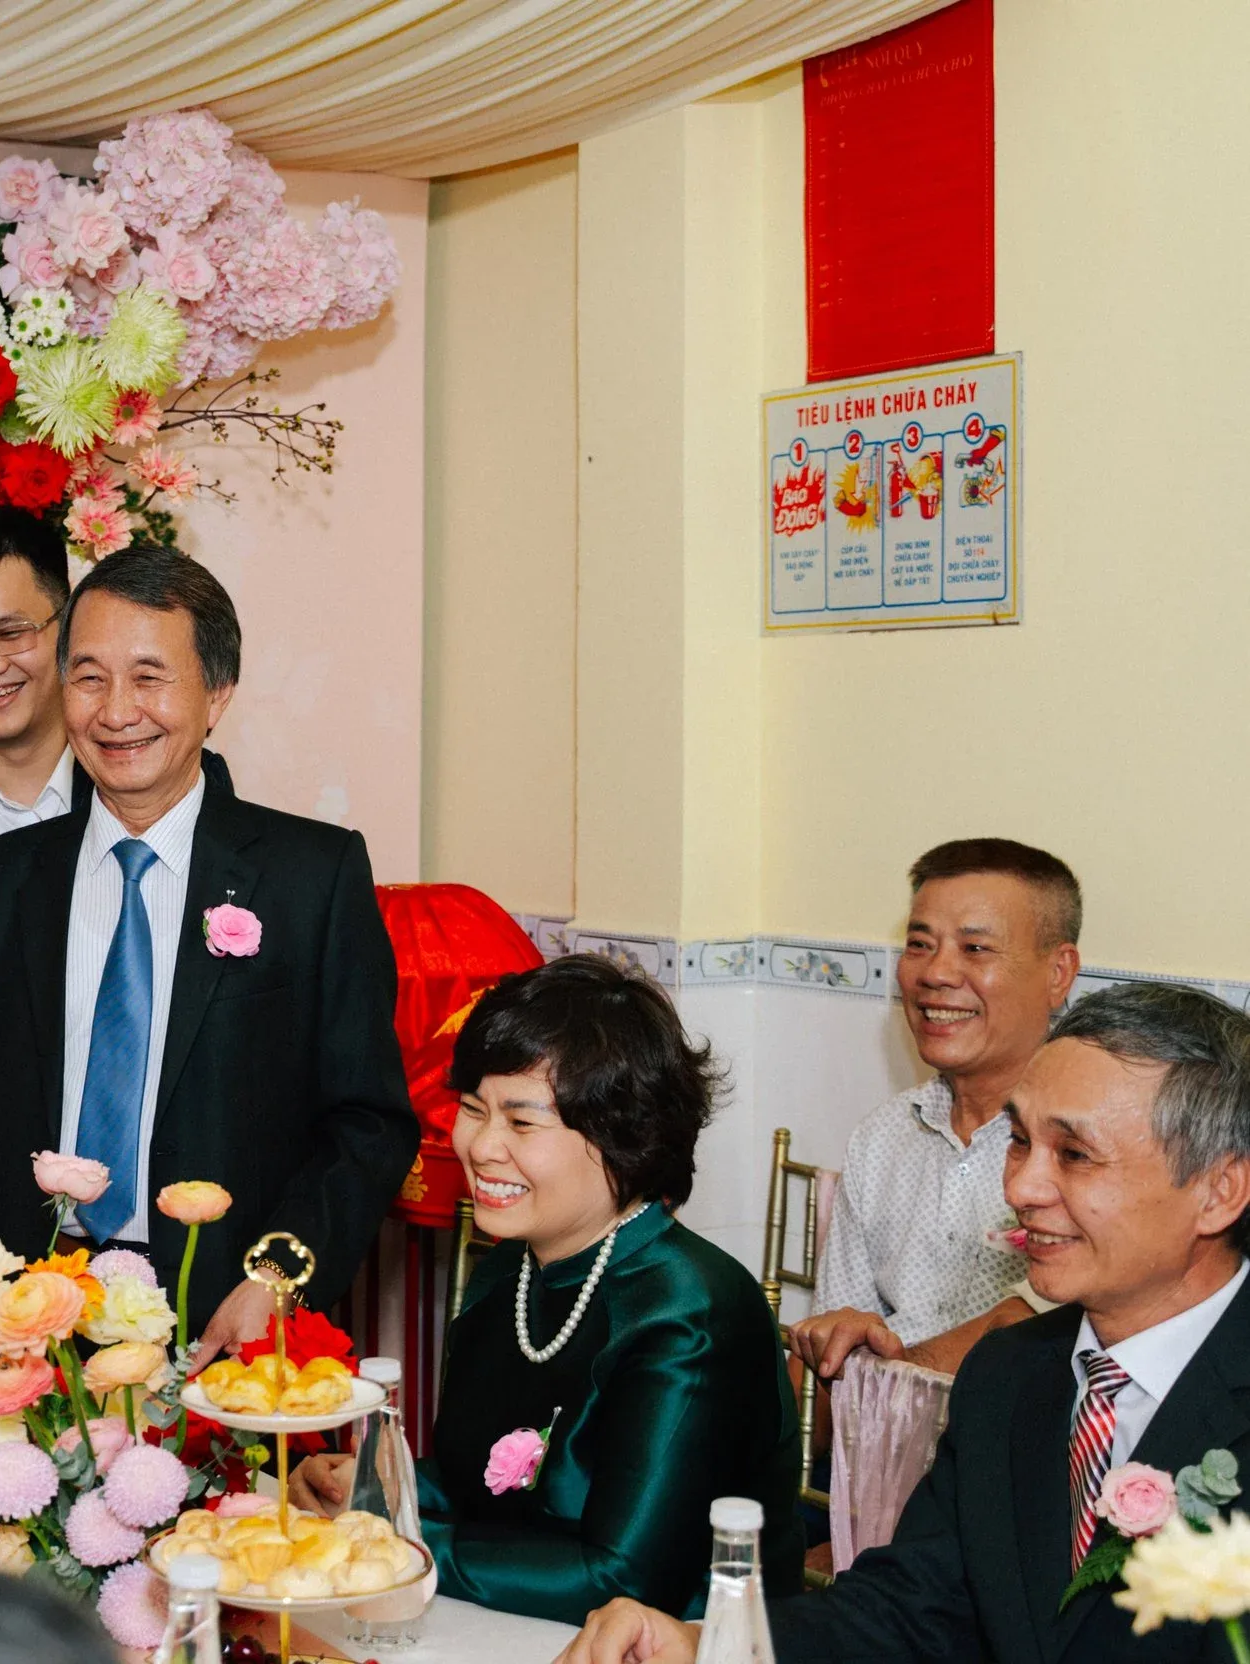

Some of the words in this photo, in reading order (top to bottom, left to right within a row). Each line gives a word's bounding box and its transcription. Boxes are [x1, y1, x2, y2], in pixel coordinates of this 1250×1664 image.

[797, 402, 829, 427] TIÊU
[835, 397, 875, 425] LỆNH
[882, 387, 926, 415] CHỮA
[907, 426, 920, 447] 3
[966, 419, 982, 438] 4
[794, 443, 803, 461] 1
[848, 433, 860, 454] 2
